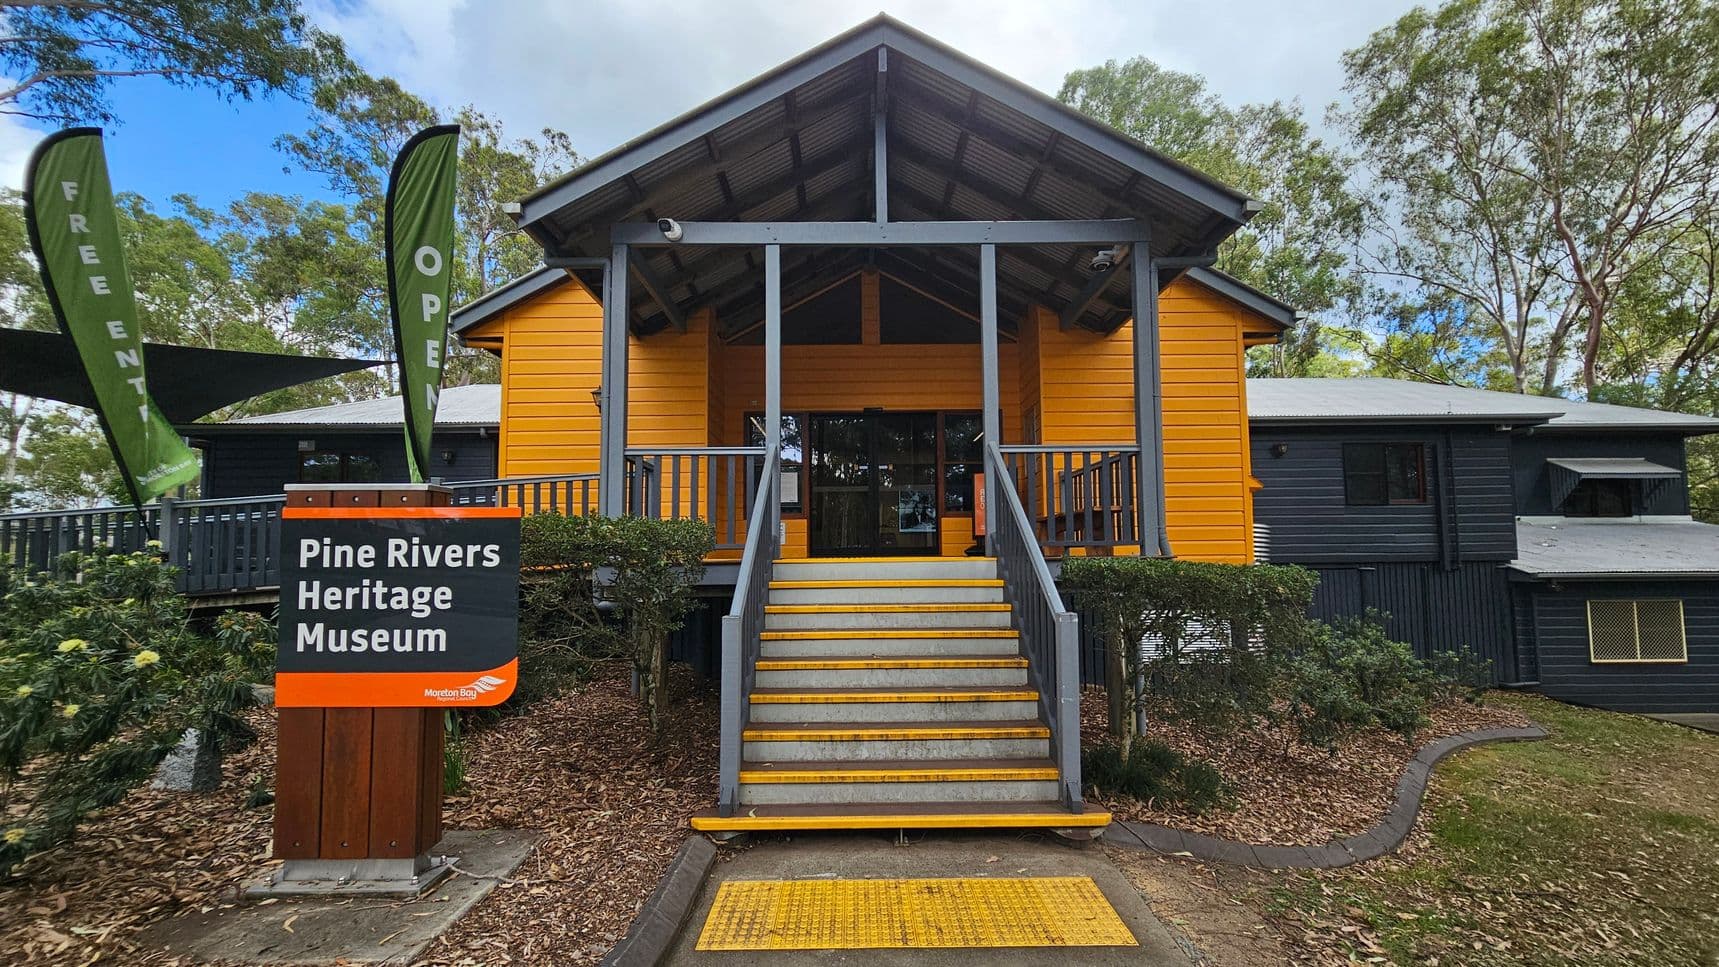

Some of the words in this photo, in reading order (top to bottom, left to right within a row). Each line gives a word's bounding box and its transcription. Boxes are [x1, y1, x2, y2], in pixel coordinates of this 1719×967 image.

[61, 181, 111, 296] FREE
[299, 537, 376, 568] Pine
[387, 537, 500, 568] Rivers
[298, 579, 453, 618] Heritage
[296, 622, 447, 653] Museum
[425, 688, 459, 697] Moreton
[460, 688, 477, 700] Bay
